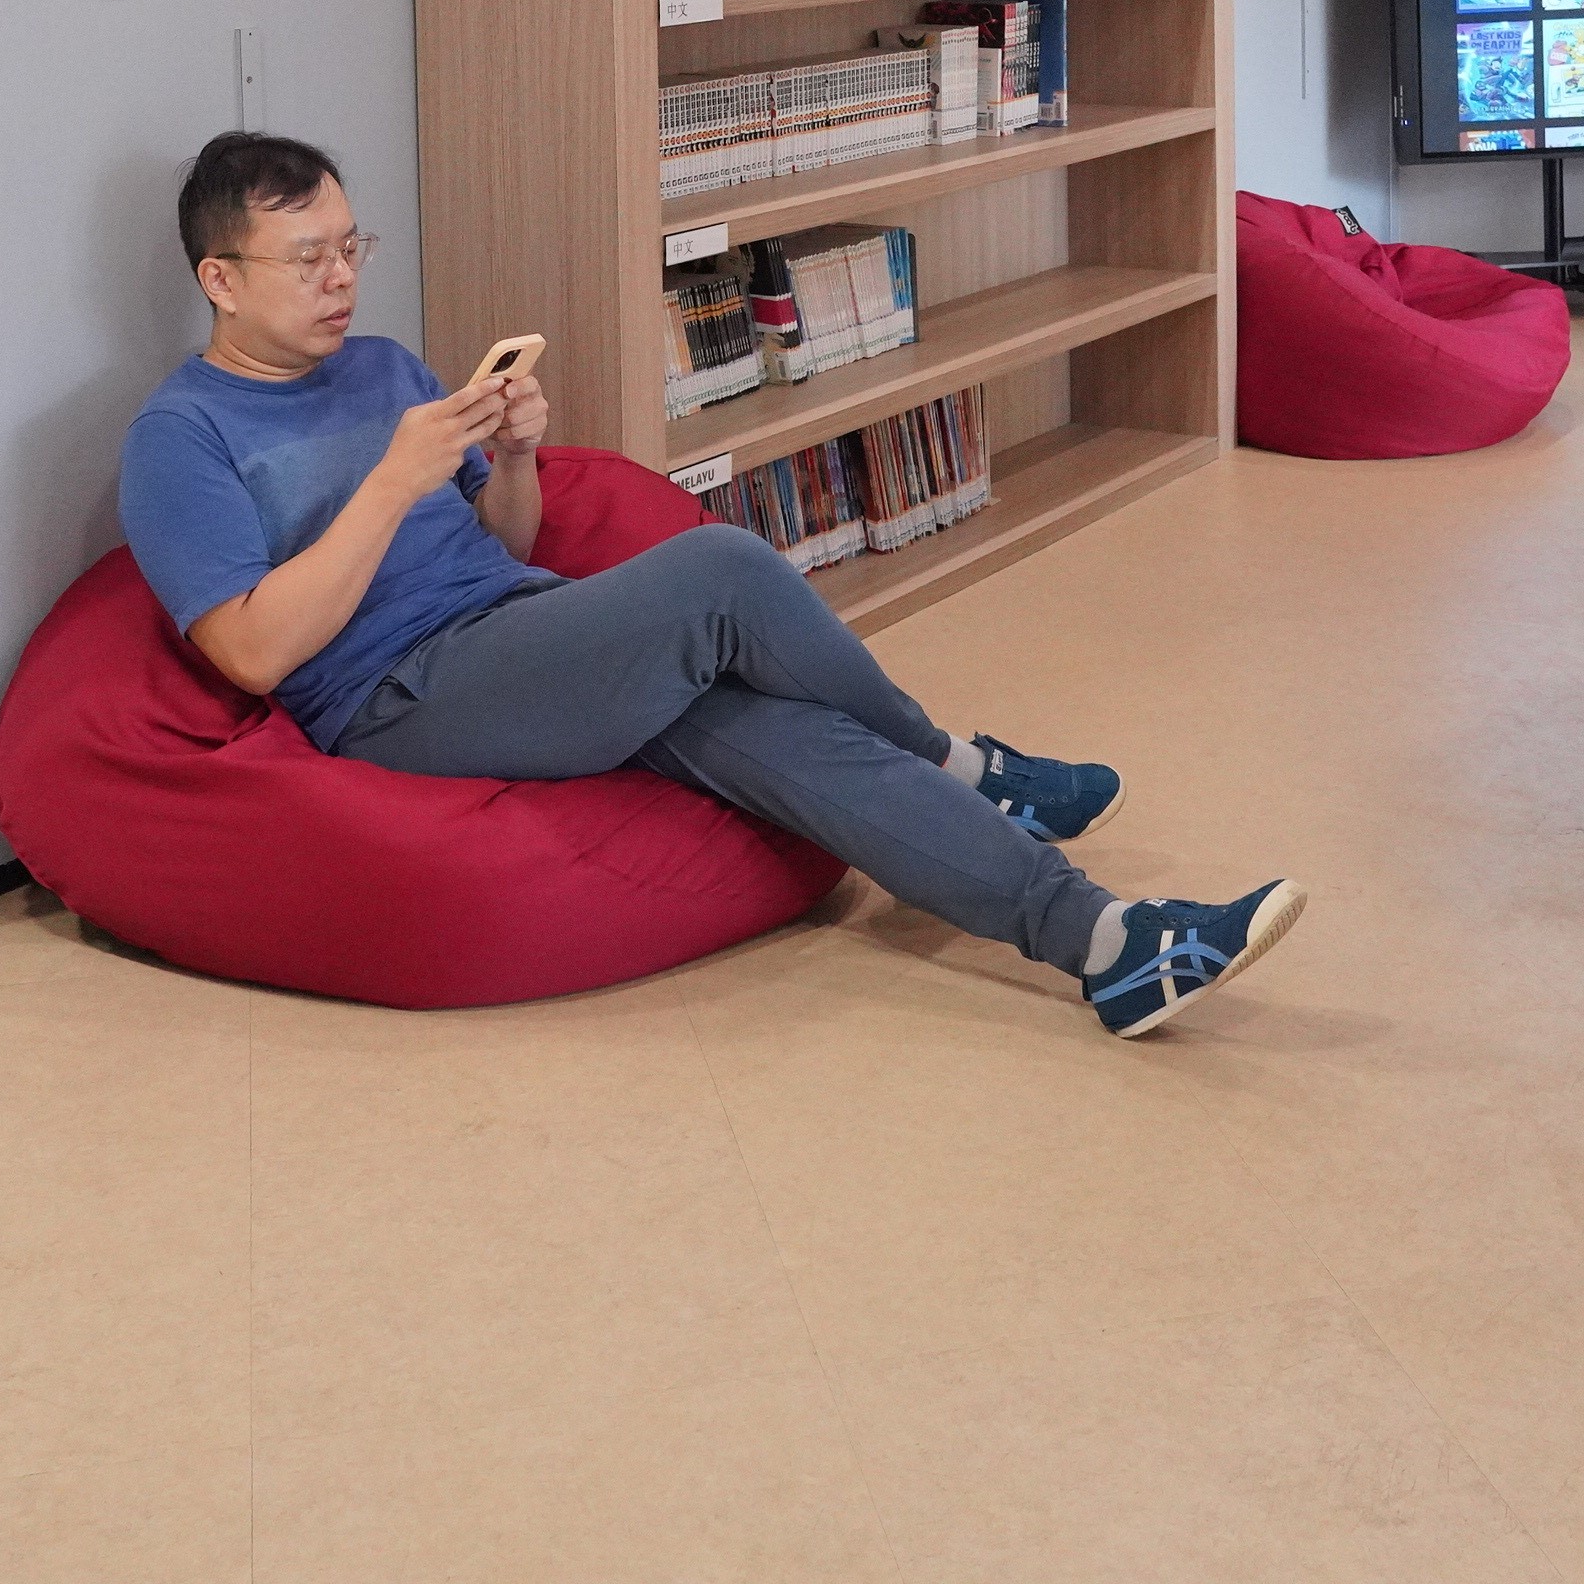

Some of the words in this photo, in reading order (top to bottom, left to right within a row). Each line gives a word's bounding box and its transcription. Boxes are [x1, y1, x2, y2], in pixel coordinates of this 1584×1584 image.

[667, 1, 688, 18] 中文
[1471, 32, 1496, 41] LAST
[1497, 31, 1522, 40] KIDS
[1483, 40, 1521, 50] EARTH
[673, 239, 694, 259] 中文
[677, 468, 715, 490] MELAYU
